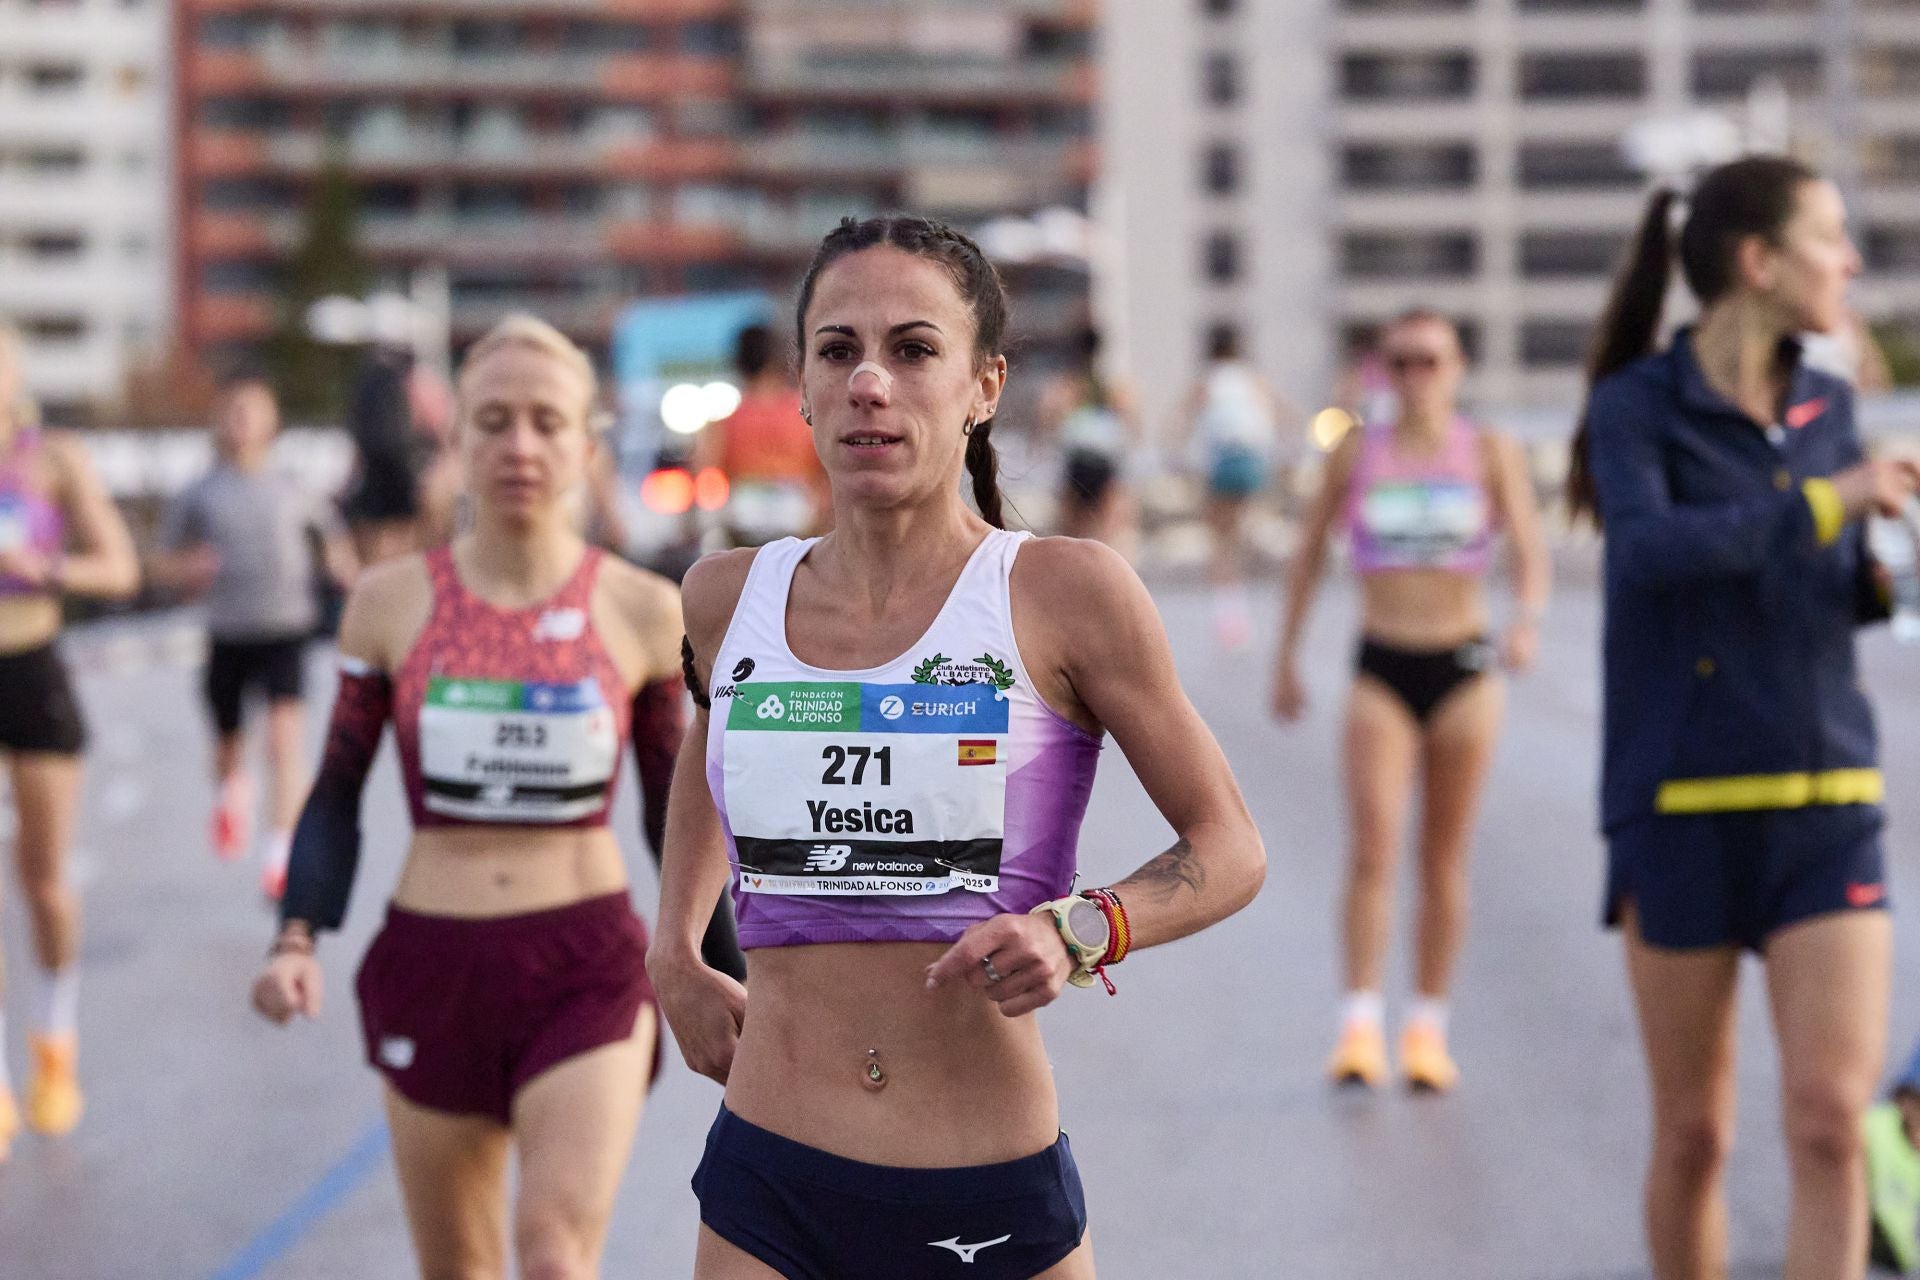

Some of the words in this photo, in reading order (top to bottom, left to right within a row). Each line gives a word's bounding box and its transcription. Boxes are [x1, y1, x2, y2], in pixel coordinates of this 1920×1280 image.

[955, 664, 991, 672] Atletismo
[935, 670, 990, 679] ALBACETE
[790, 689, 844, 699] FUNDACIÓN
[788, 700, 843, 712] TRINIDAD
[787, 712, 842, 723] ALFONSO
[821, 745, 891, 786] 271
[806, 800, 914, 834] Yesica
[852, 862, 875, 871] new
[877, 861, 924, 872] balance
[816, 880, 865, 891] TRINIDAD
[866, 880, 923, 892] ALFONSO
